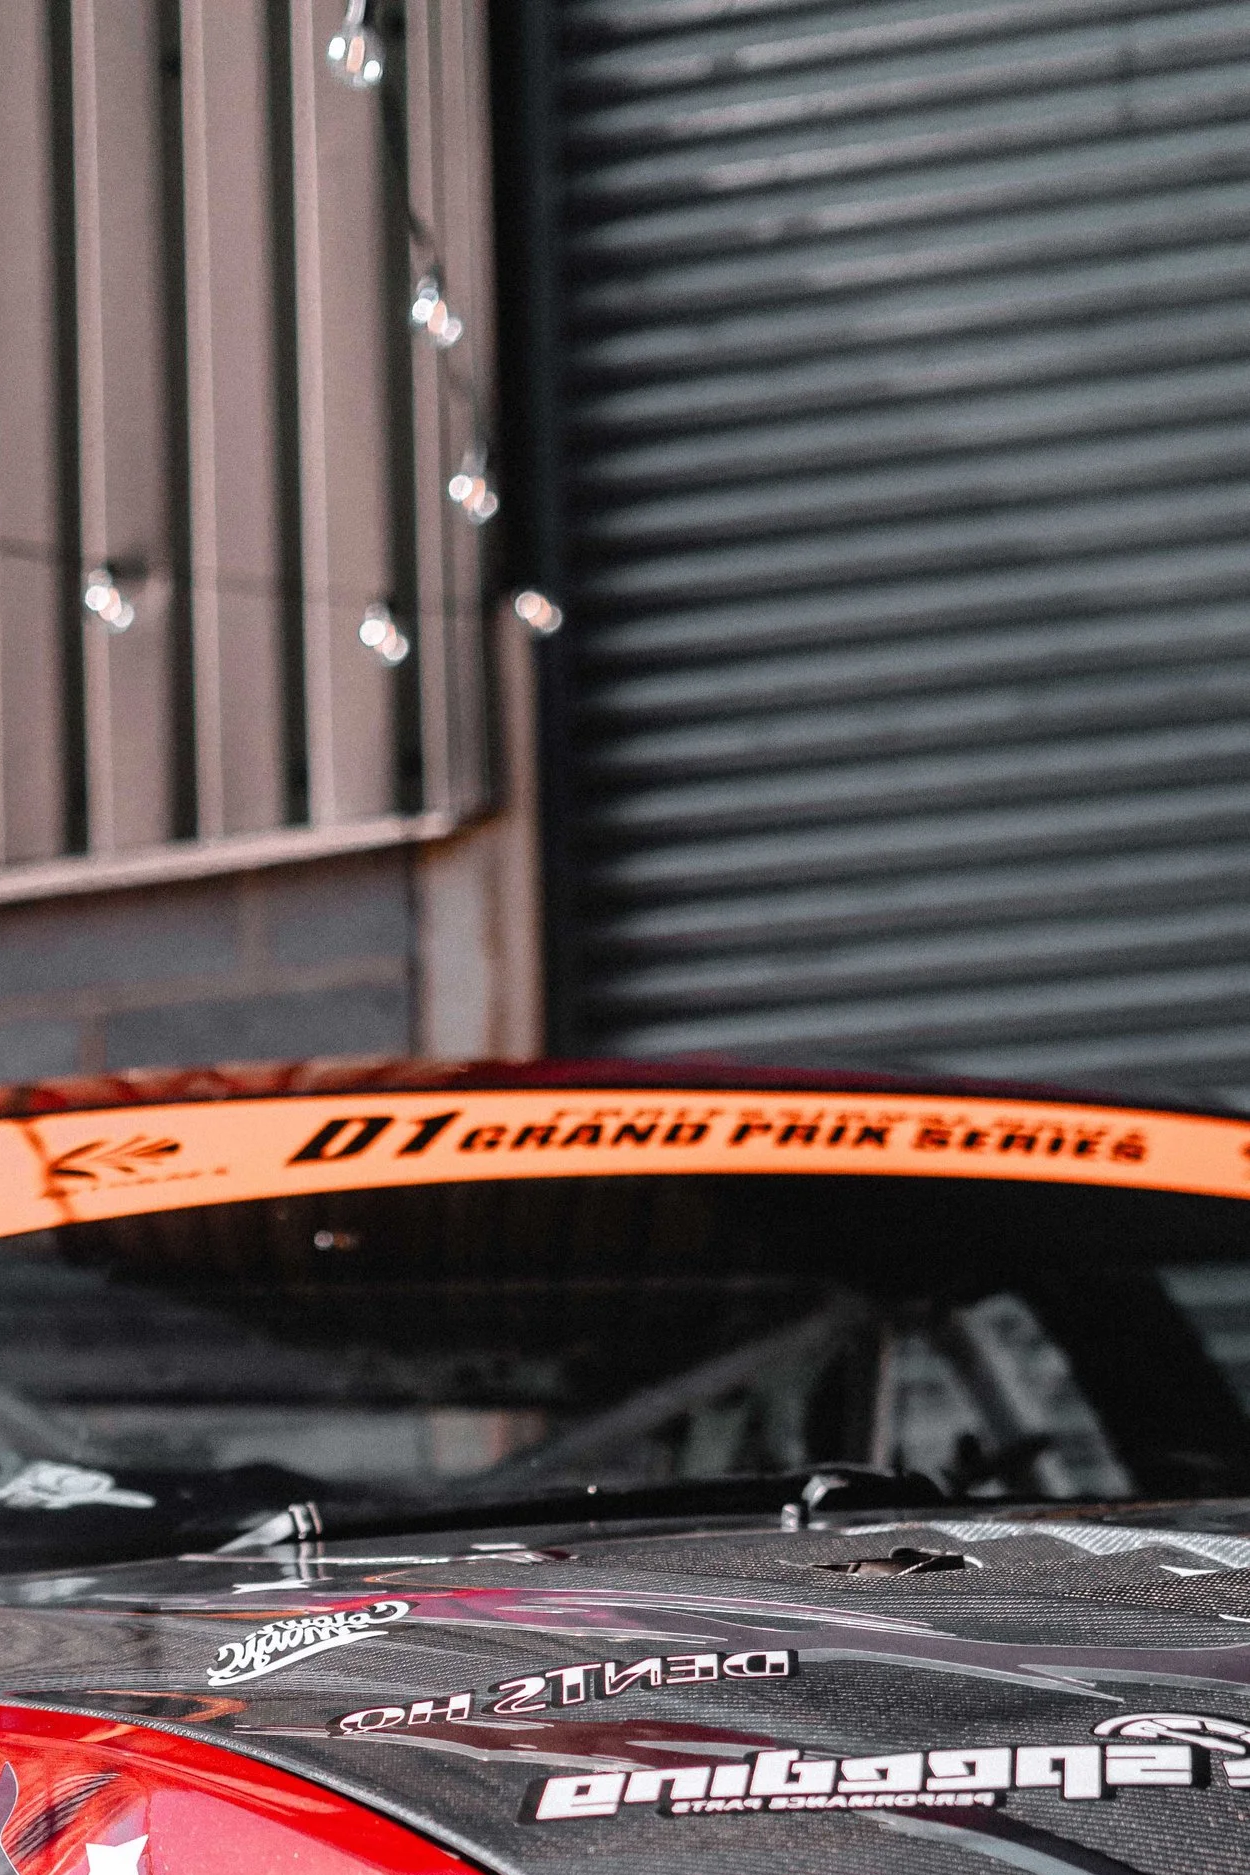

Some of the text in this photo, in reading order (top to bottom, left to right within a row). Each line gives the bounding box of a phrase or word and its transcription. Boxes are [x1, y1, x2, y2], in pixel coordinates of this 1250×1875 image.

[286, 1110, 1147, 1168] D1 GRAND PRIX SERIES
